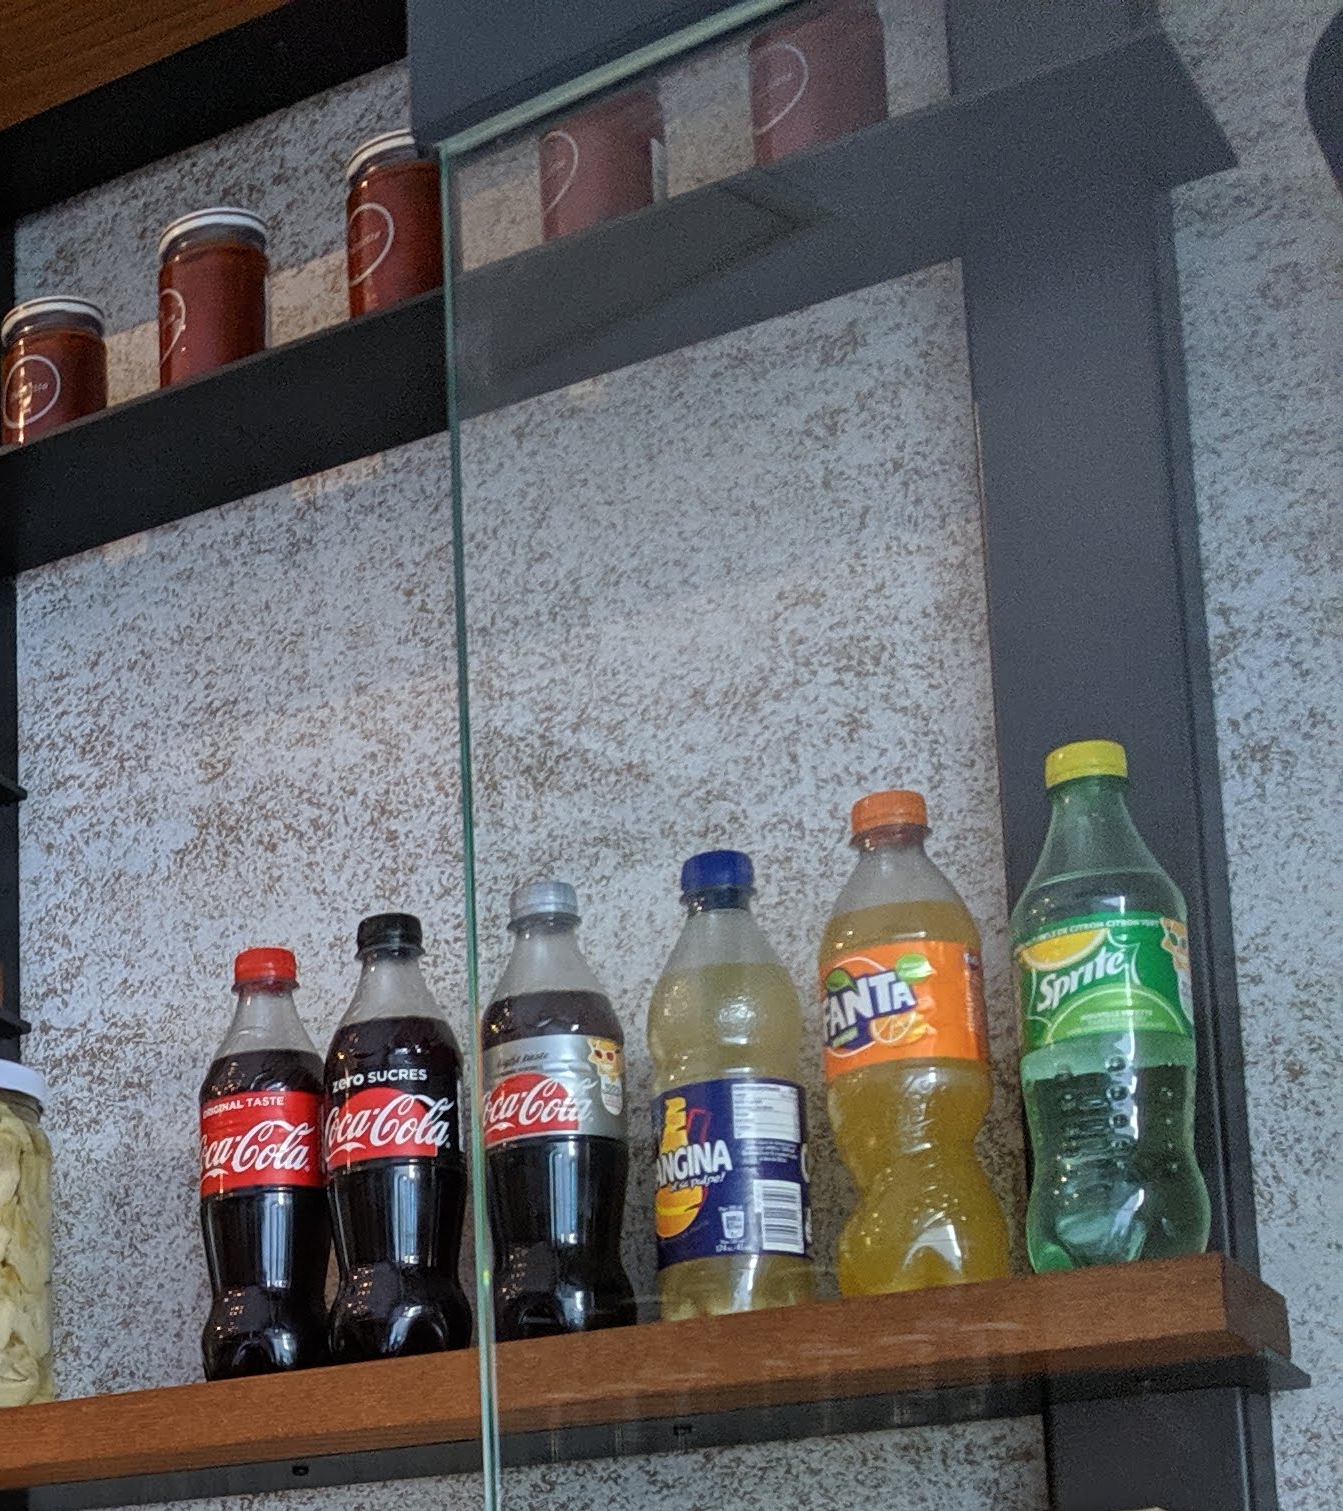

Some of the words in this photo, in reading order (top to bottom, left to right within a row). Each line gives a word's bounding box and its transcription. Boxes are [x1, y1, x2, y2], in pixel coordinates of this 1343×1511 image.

[1036, 946, 1127, 1013] Sprite
[331, 1073, 364, 1094] zero
[367, 1068, 428, 1085] SUCRES
[246, 1096, 284, 1107] TASTE
[656, 1139, 733, 1184] ANGINA
